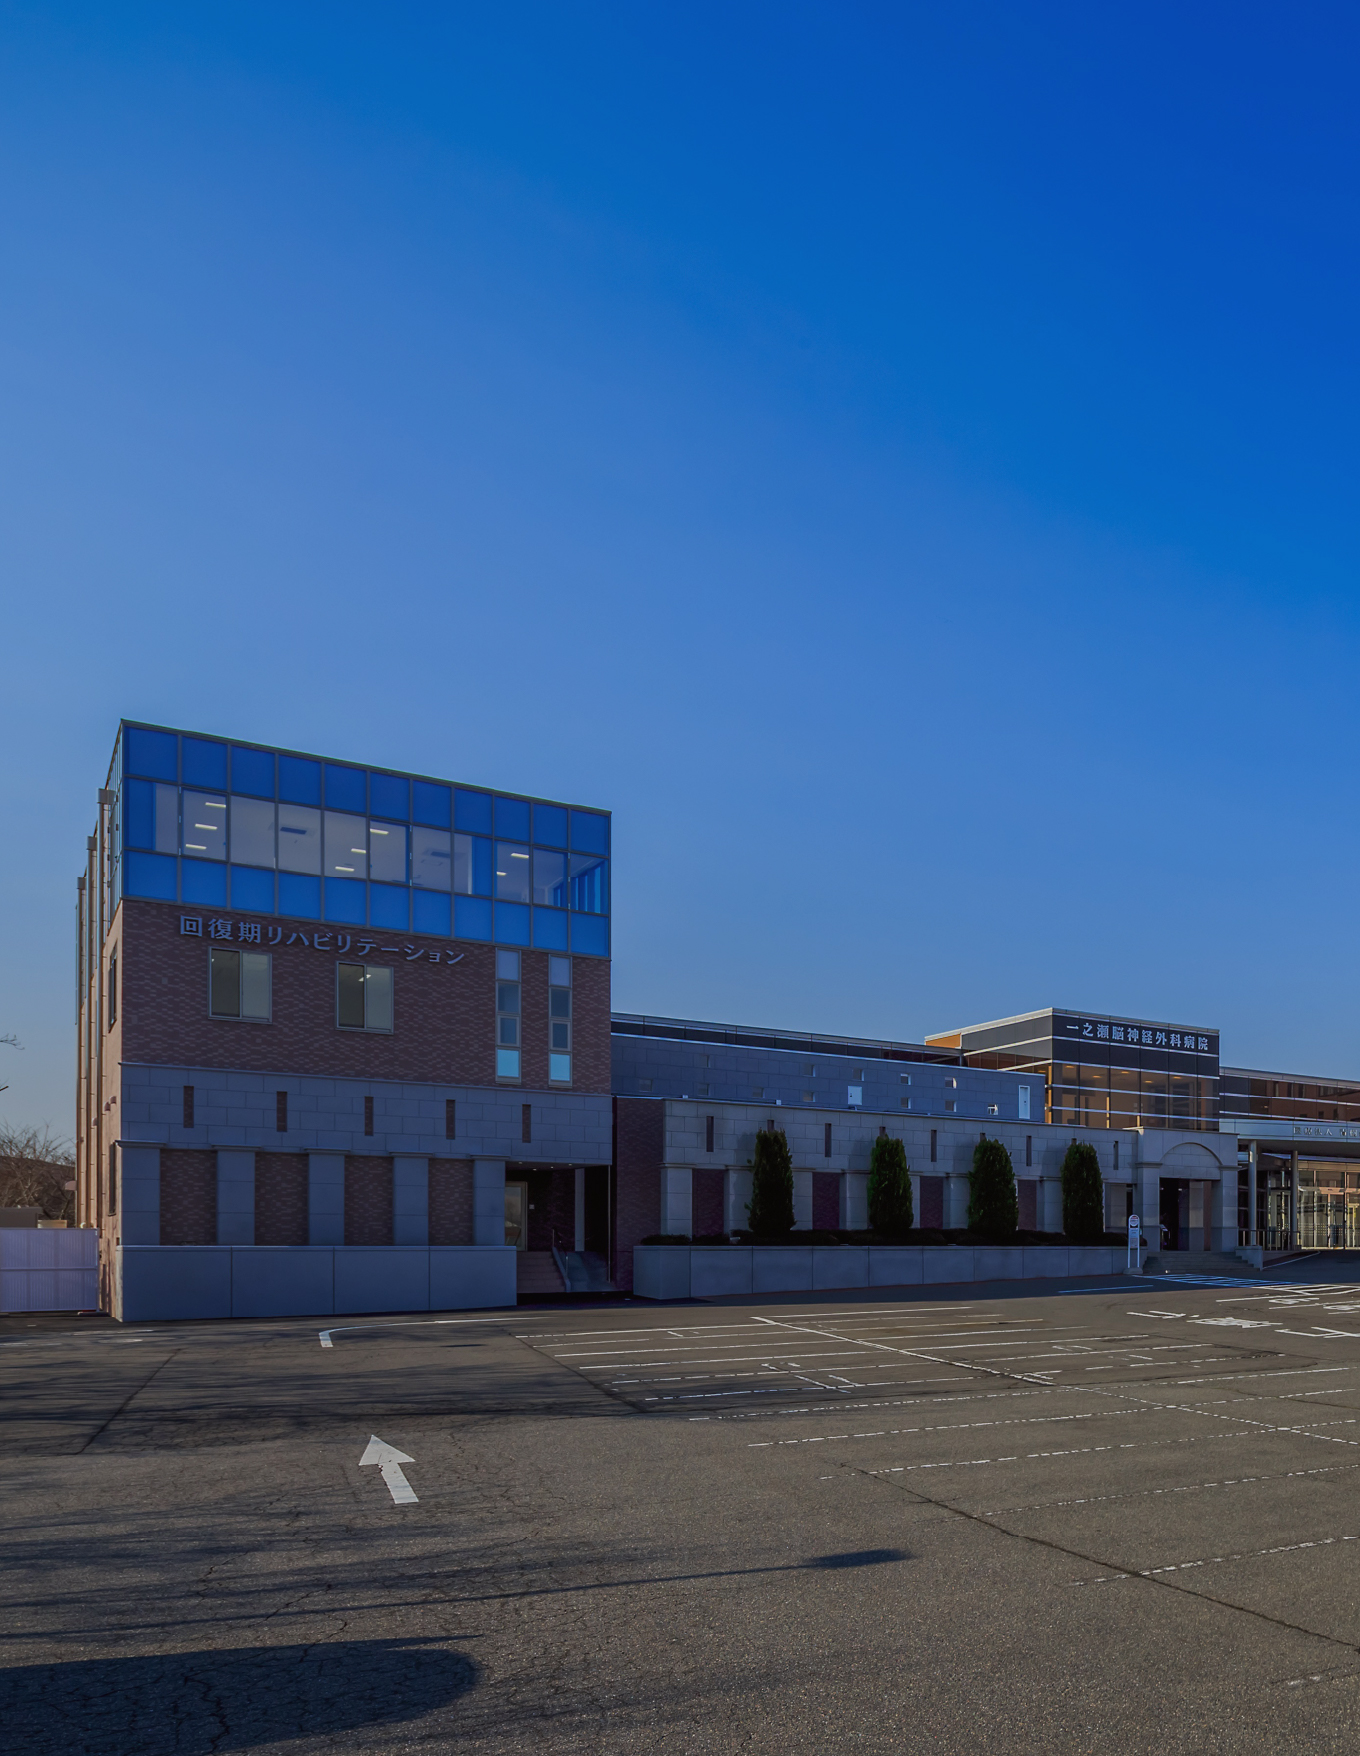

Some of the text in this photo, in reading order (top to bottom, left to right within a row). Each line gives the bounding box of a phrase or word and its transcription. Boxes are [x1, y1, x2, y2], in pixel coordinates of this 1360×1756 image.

[180, 914, 465, 965] 回復期リハビリテーション
[1066, 1022, 1209, 1051] 一之瀬脳神経外科病院
